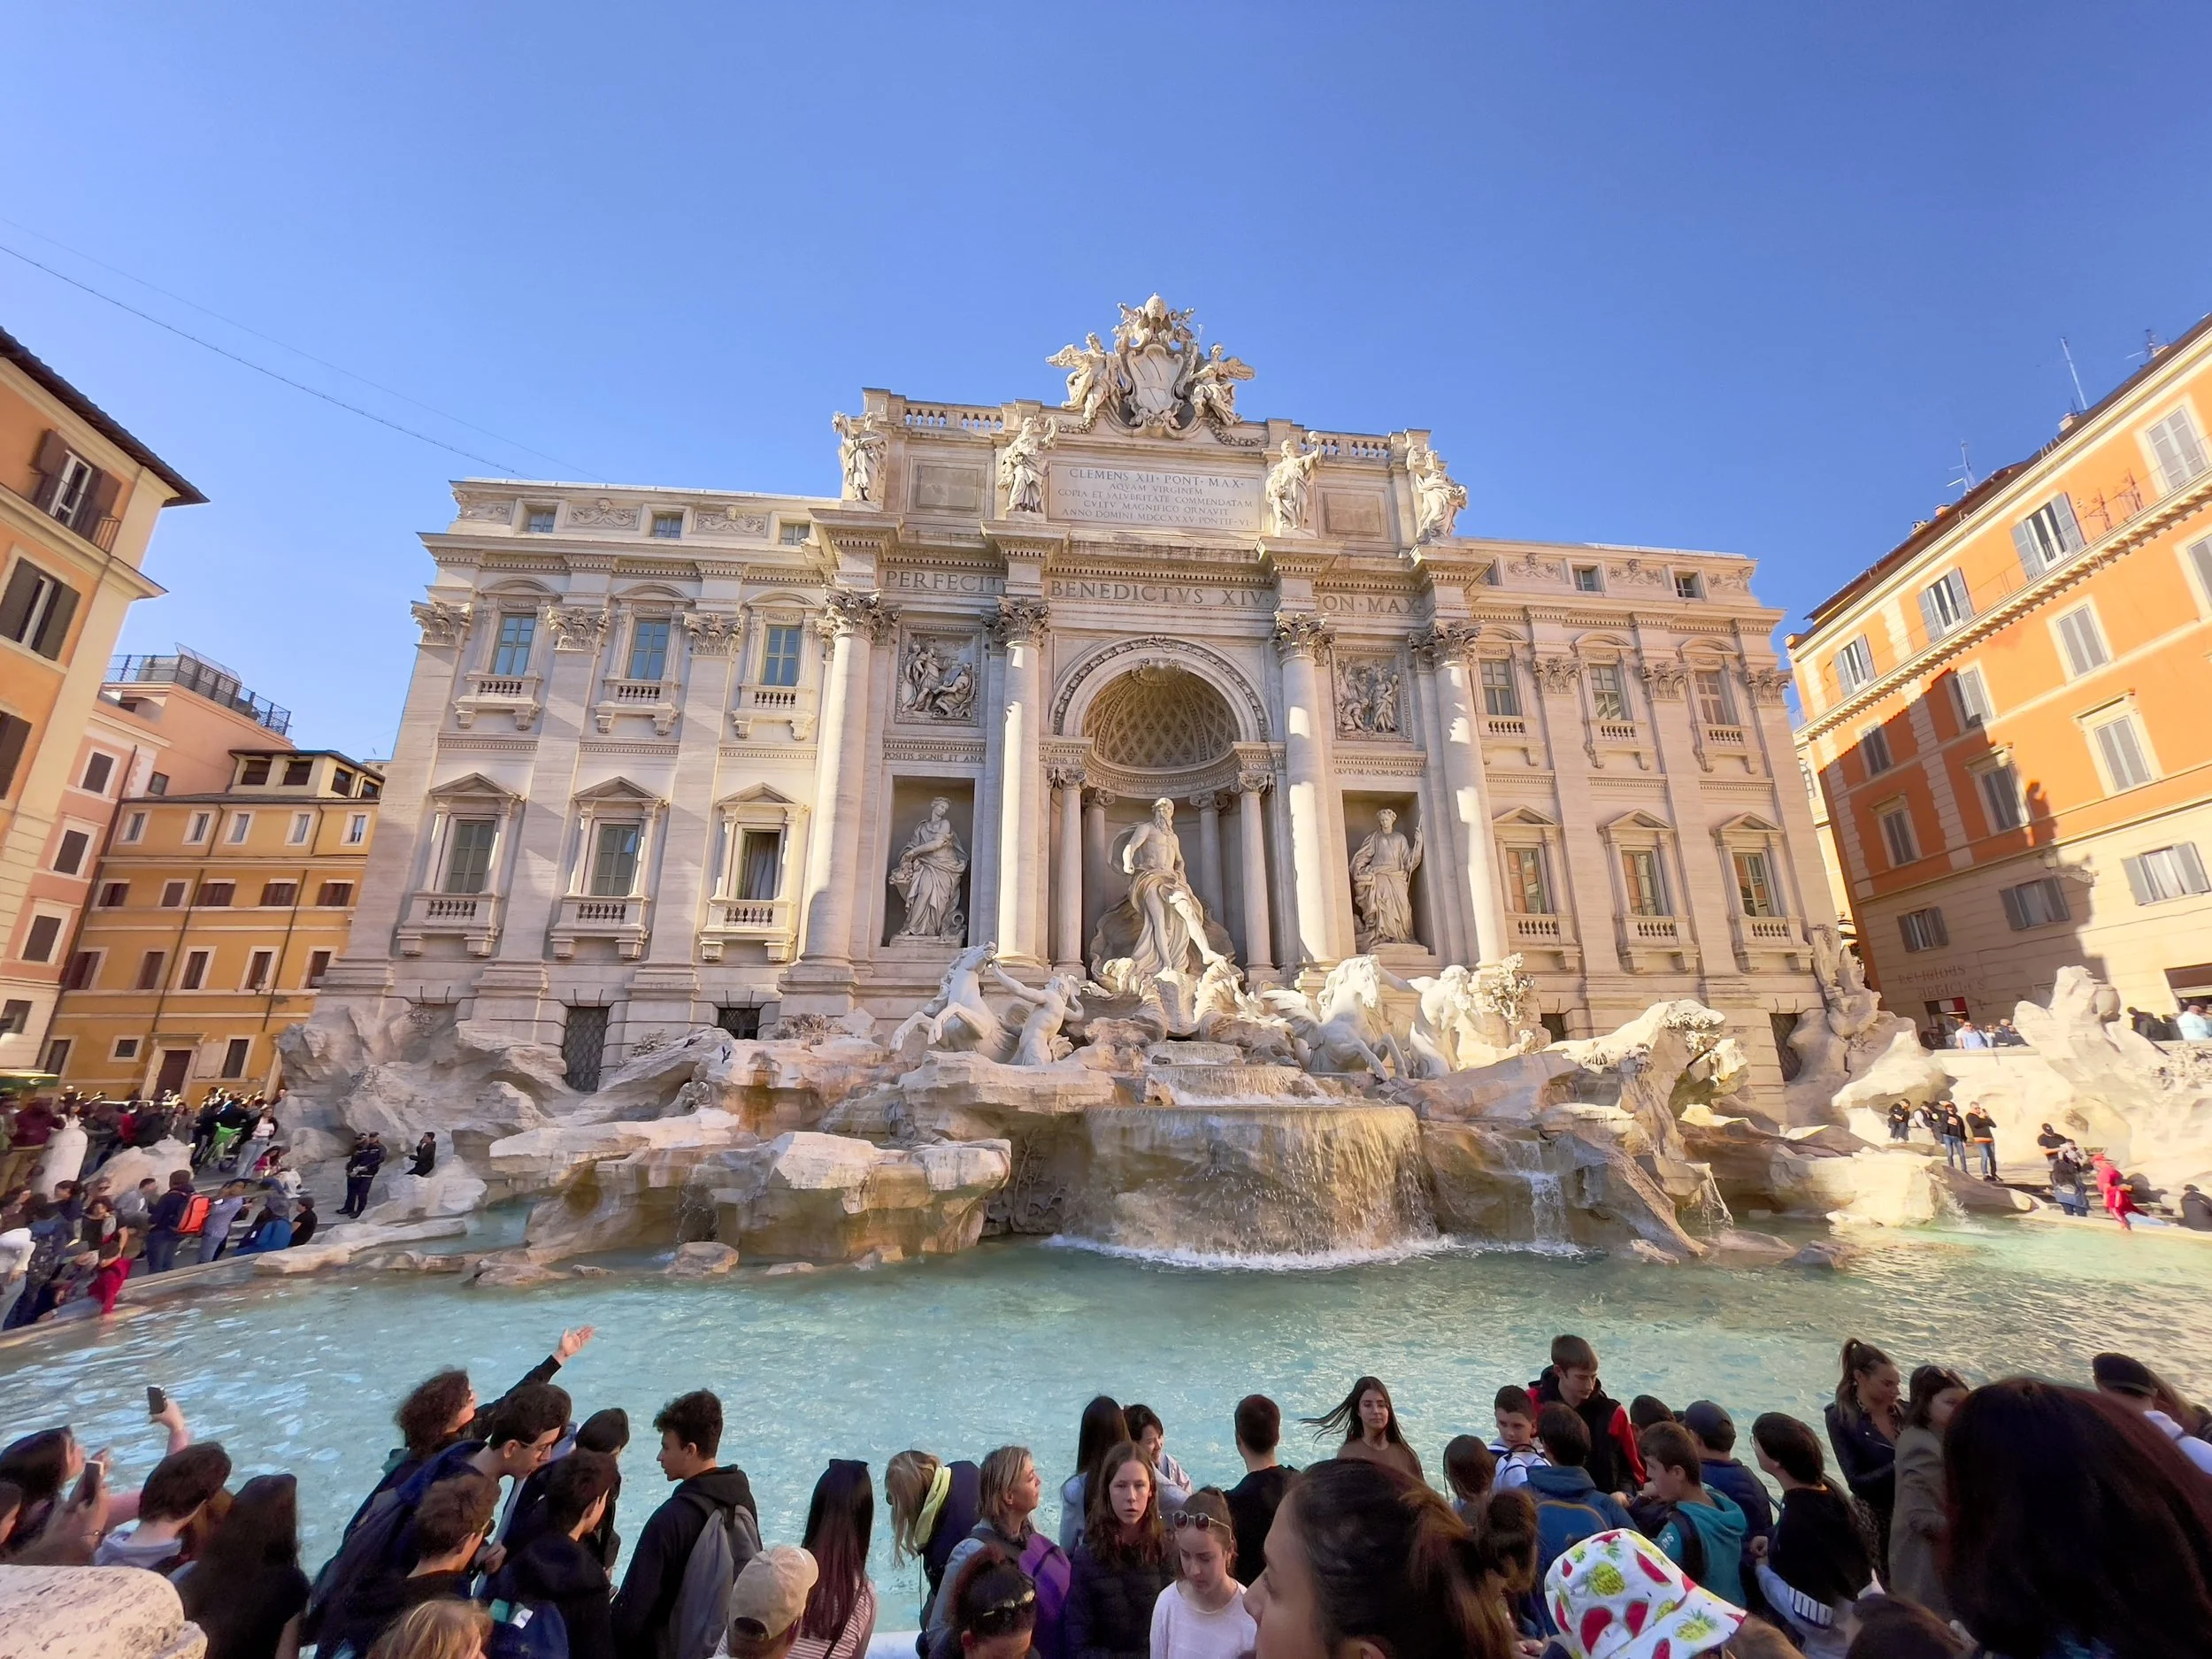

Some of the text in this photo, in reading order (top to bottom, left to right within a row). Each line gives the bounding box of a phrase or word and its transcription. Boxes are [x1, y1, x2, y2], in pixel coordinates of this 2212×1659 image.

[1070, 468, 1129, 481] CLEMENS
[1153, 485, 1202, 495] VIRGINEM
[1058, 488, 1087, 497] COPIA
[1175, 496, 1253, 508] COMMENDATAM
[1062, 509, 1093, 518] ANNO
[1095, 511, 1133, 520] DOMINI
[1122, 503, 1179, 513] MAGNIFICO
[1184, 506, 1228, 516] ORNAVIT
[885, 571, 1002, 592] PERFECIT
[1051, 580, 1203, 604] BENEDICTVS
